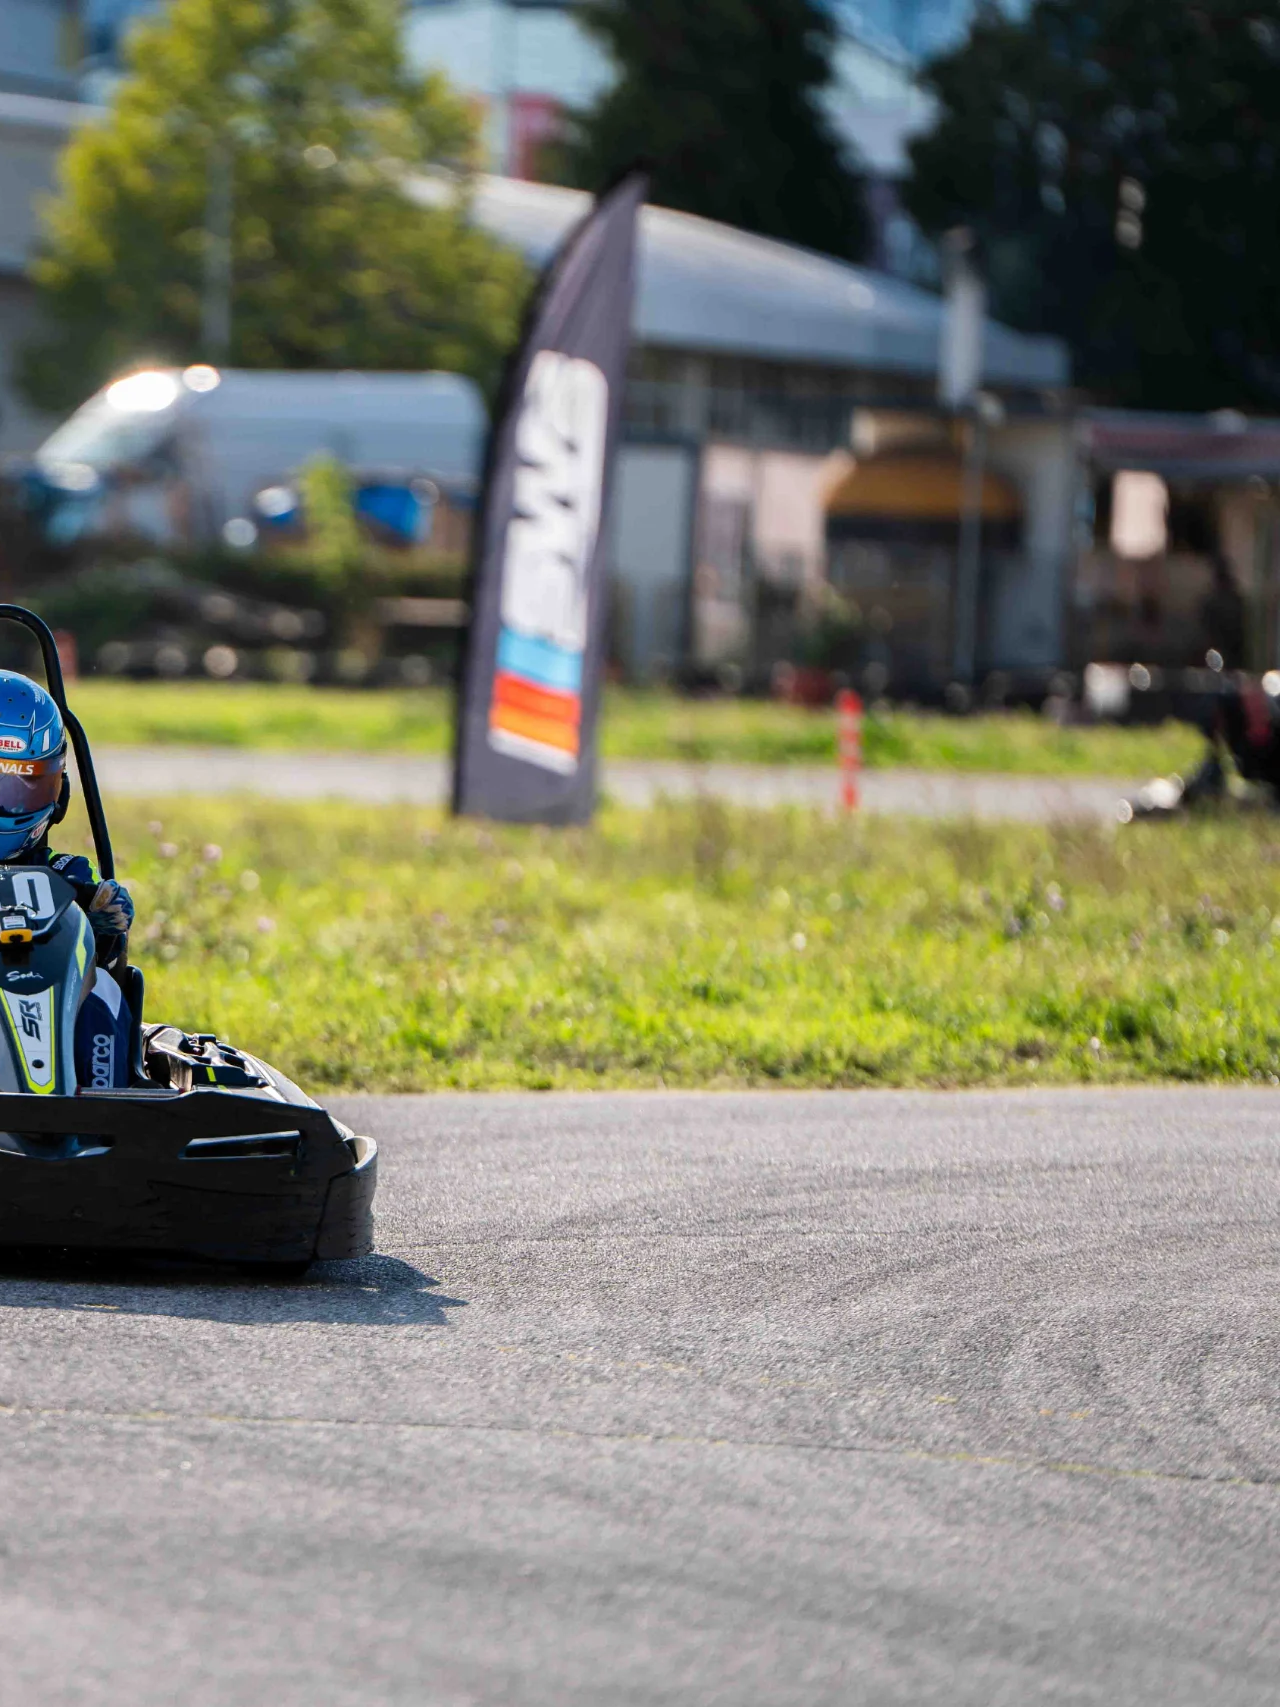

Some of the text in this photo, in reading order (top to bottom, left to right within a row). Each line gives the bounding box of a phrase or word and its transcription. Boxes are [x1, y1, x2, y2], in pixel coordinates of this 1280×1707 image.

[6, 970, 45, 982] Sodi
[19, 999, 42, 1042] SR
[92, 1034, 115, 1088] parco
